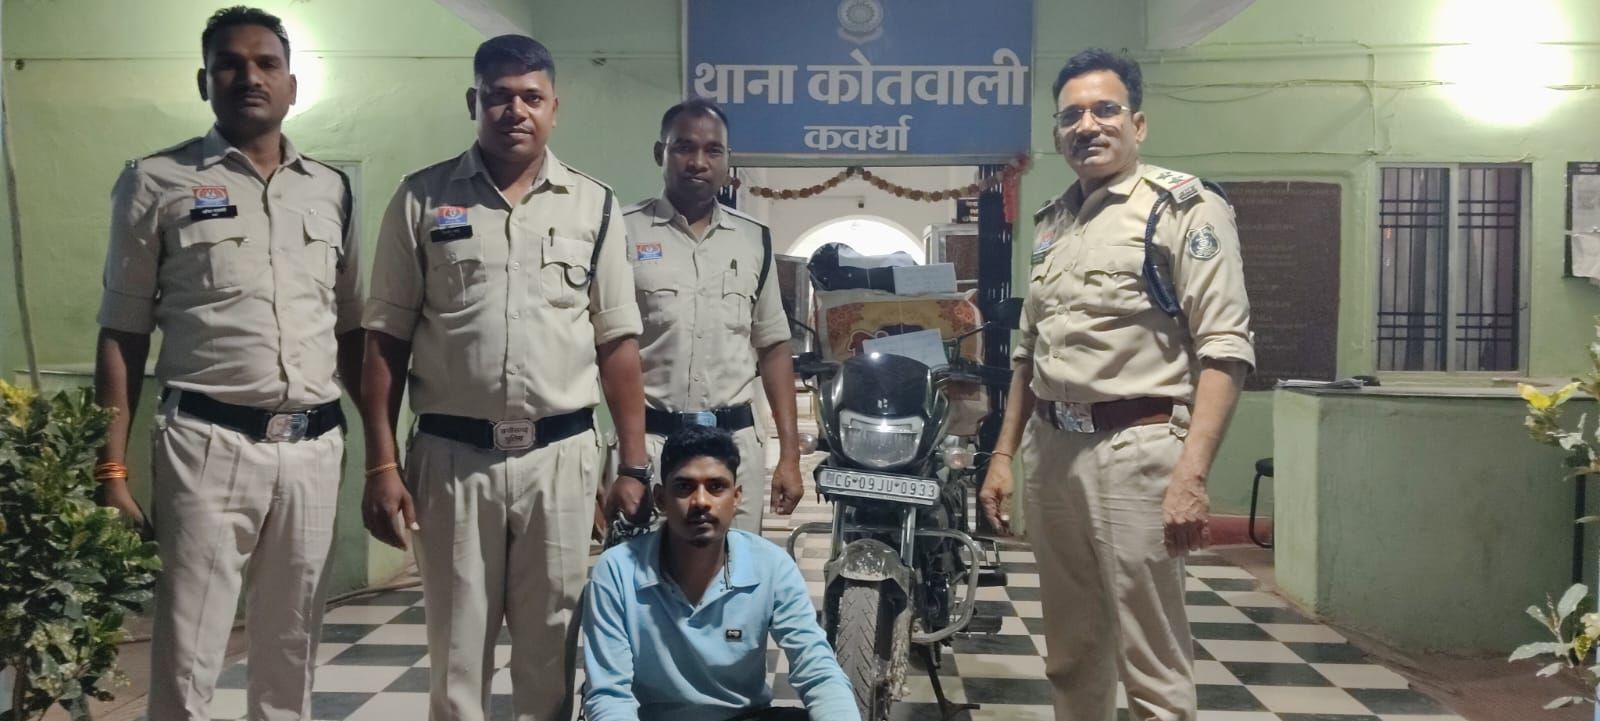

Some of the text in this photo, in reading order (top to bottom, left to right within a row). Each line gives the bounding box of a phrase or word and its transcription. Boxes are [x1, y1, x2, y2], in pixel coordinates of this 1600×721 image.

[694, 48, 1028, 106] थाना कोतवाली
[804, 115, 913, 151] कवर्धा
